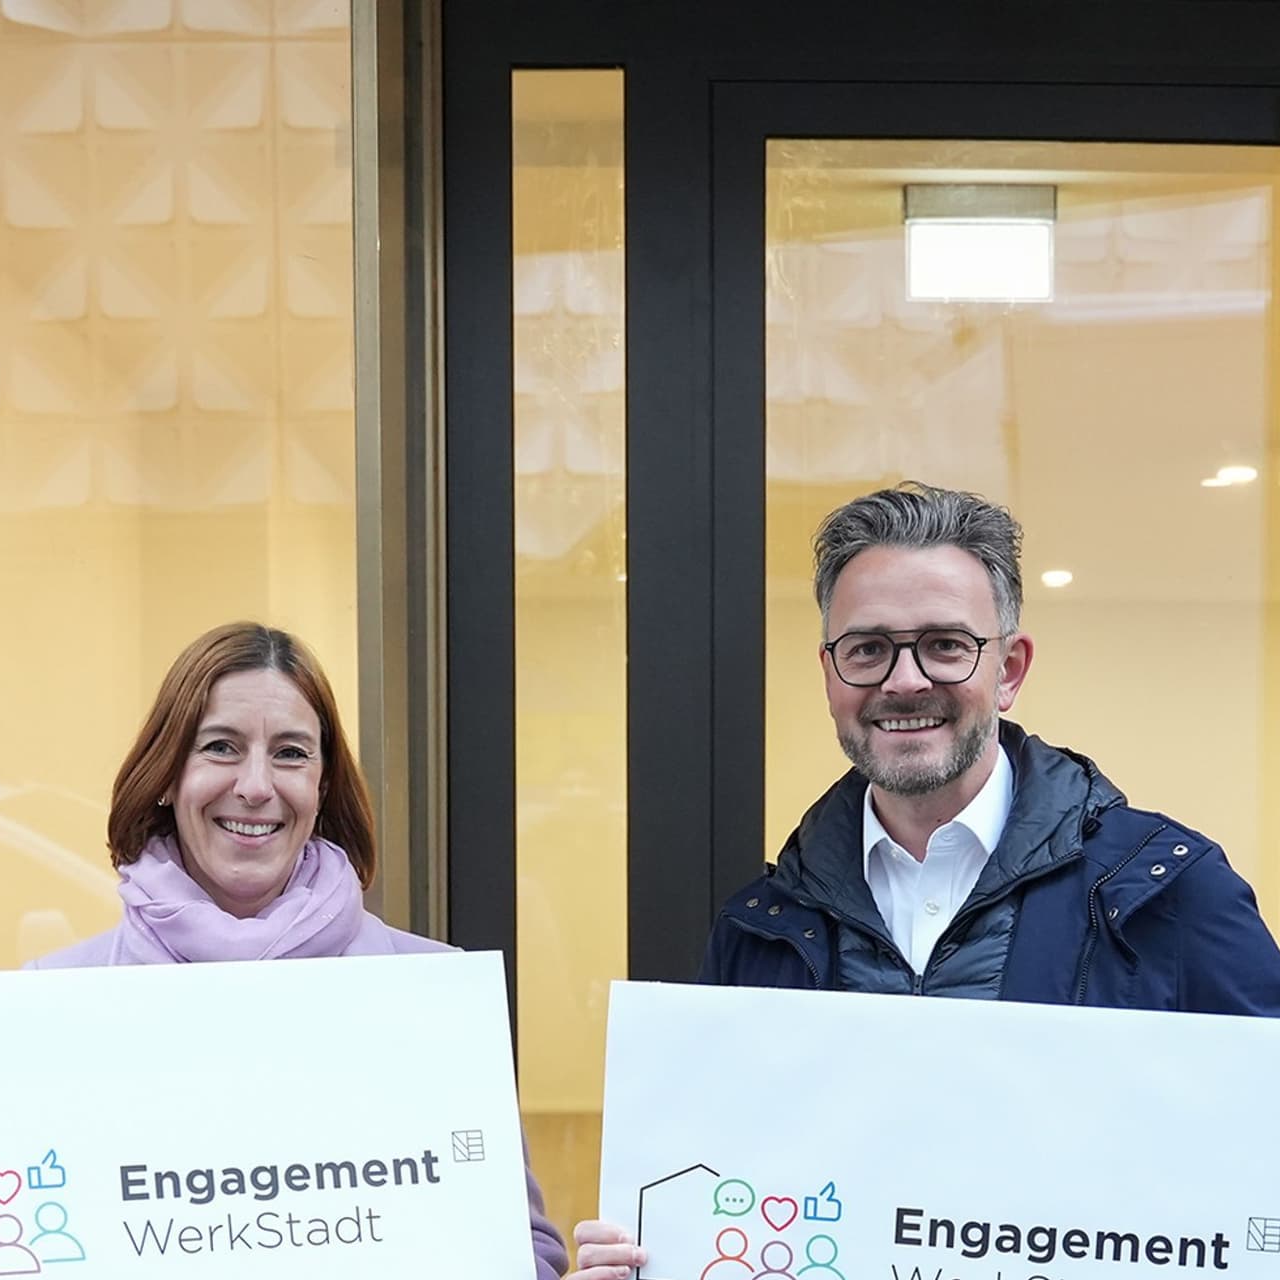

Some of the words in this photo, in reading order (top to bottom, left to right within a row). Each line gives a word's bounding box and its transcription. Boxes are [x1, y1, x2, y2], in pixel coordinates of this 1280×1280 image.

[119, 1149, 441, 1206] Engagement
[122, 1205, 384, 1257] WerkStadt
[893, 1206, 1231, 1271] Engagement
